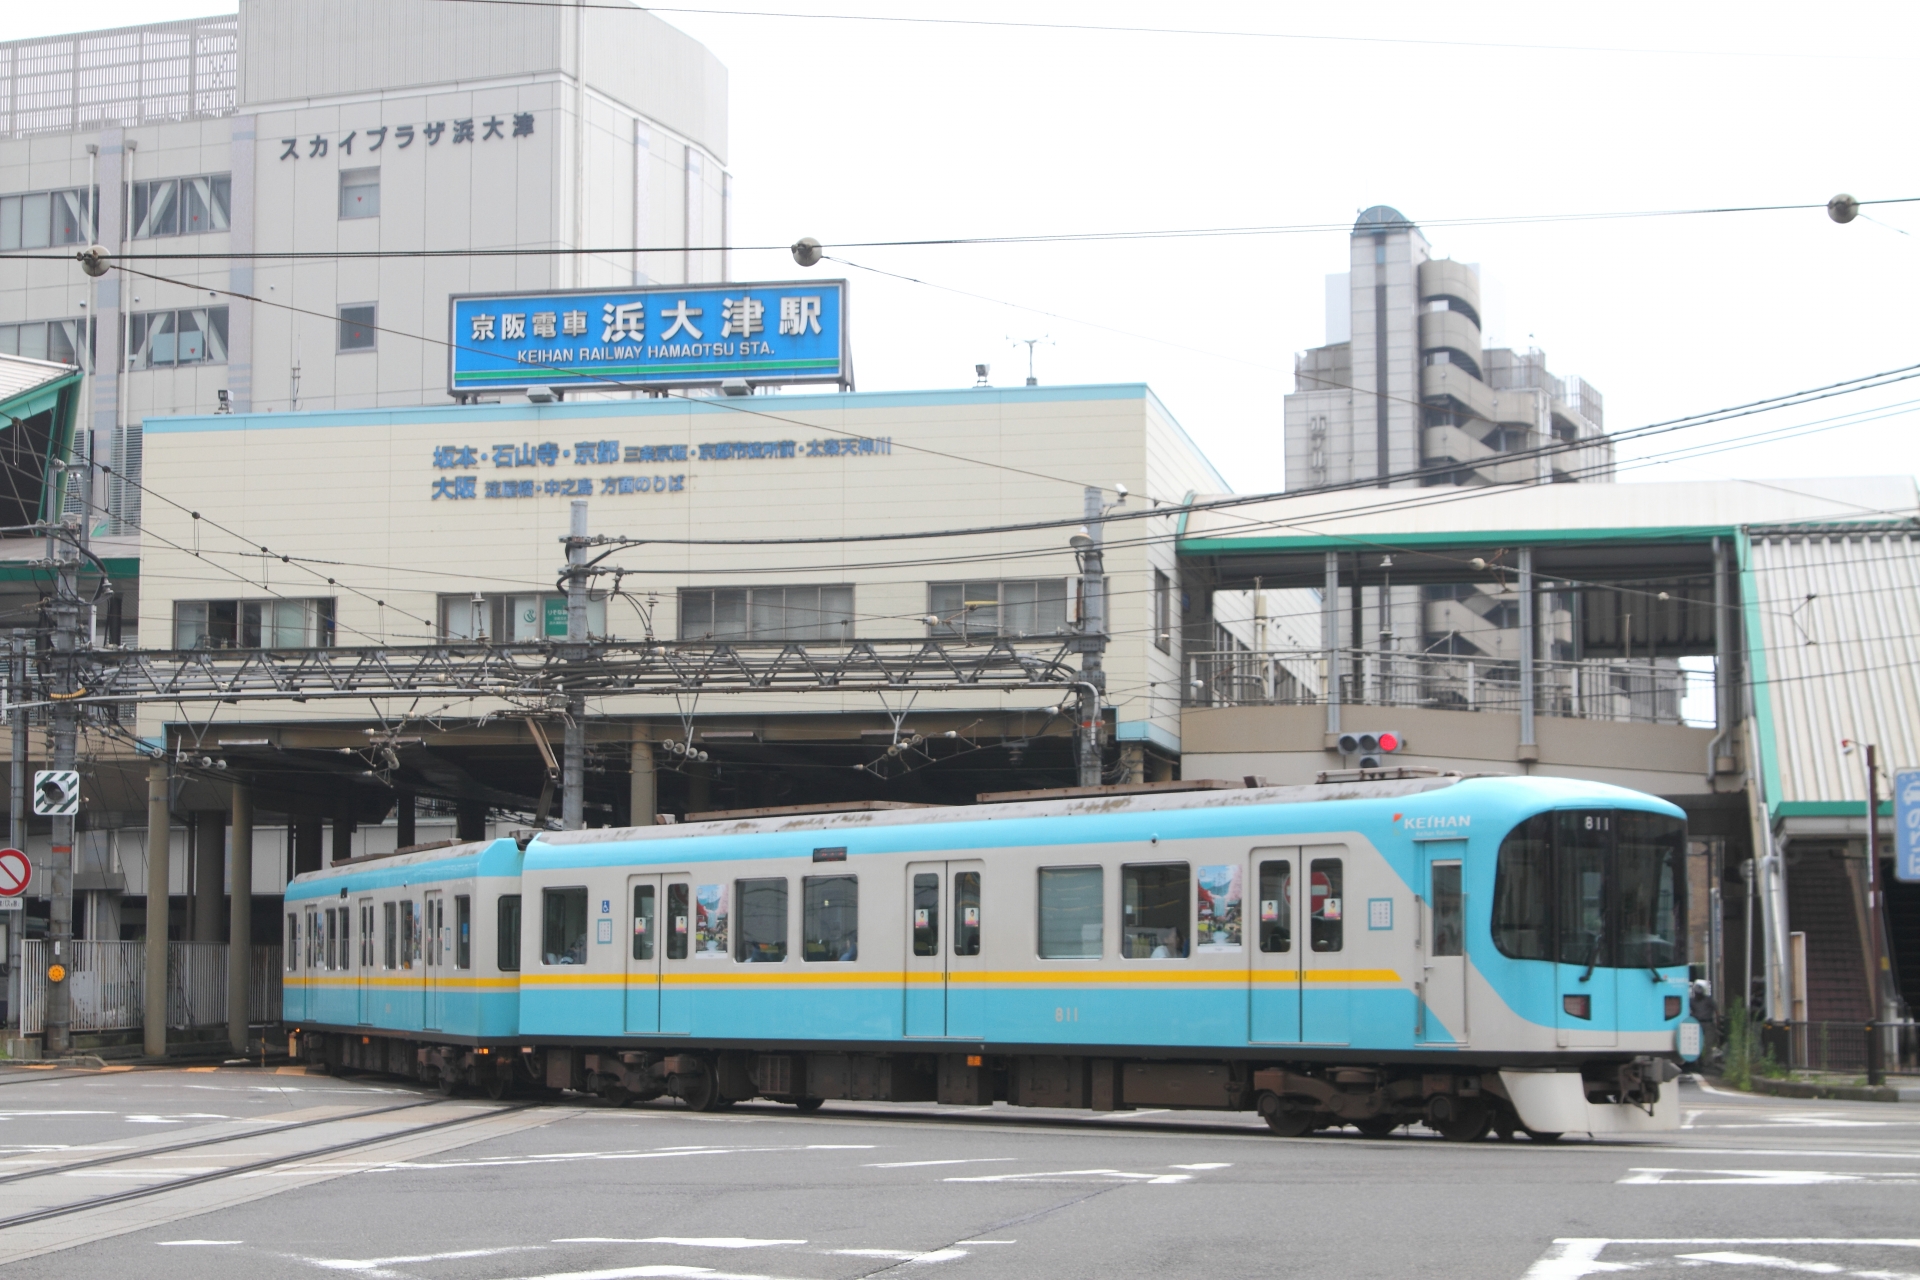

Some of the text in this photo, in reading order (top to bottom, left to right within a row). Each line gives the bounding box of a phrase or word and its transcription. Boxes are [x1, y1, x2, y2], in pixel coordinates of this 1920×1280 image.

[280, 112, 535, 160] スカイプラザ浜大津
[471, 296, 823, 343] 京阪電車 浜大津駅
[518, 341, 775, 364] KEIHAN RAILWAY HAMAOTSU STA.
[433, 440, 620, 469] 坂本・石山寺・京都
[431, 475, 477, 500] 大阪
[600, 474, 685, 496] 方面のりば
[1404, 815, 1471, 829] KEIHAN
[1585, 815, 1609, 830] 811
[1054, 1007, 1079, 1023] 811
